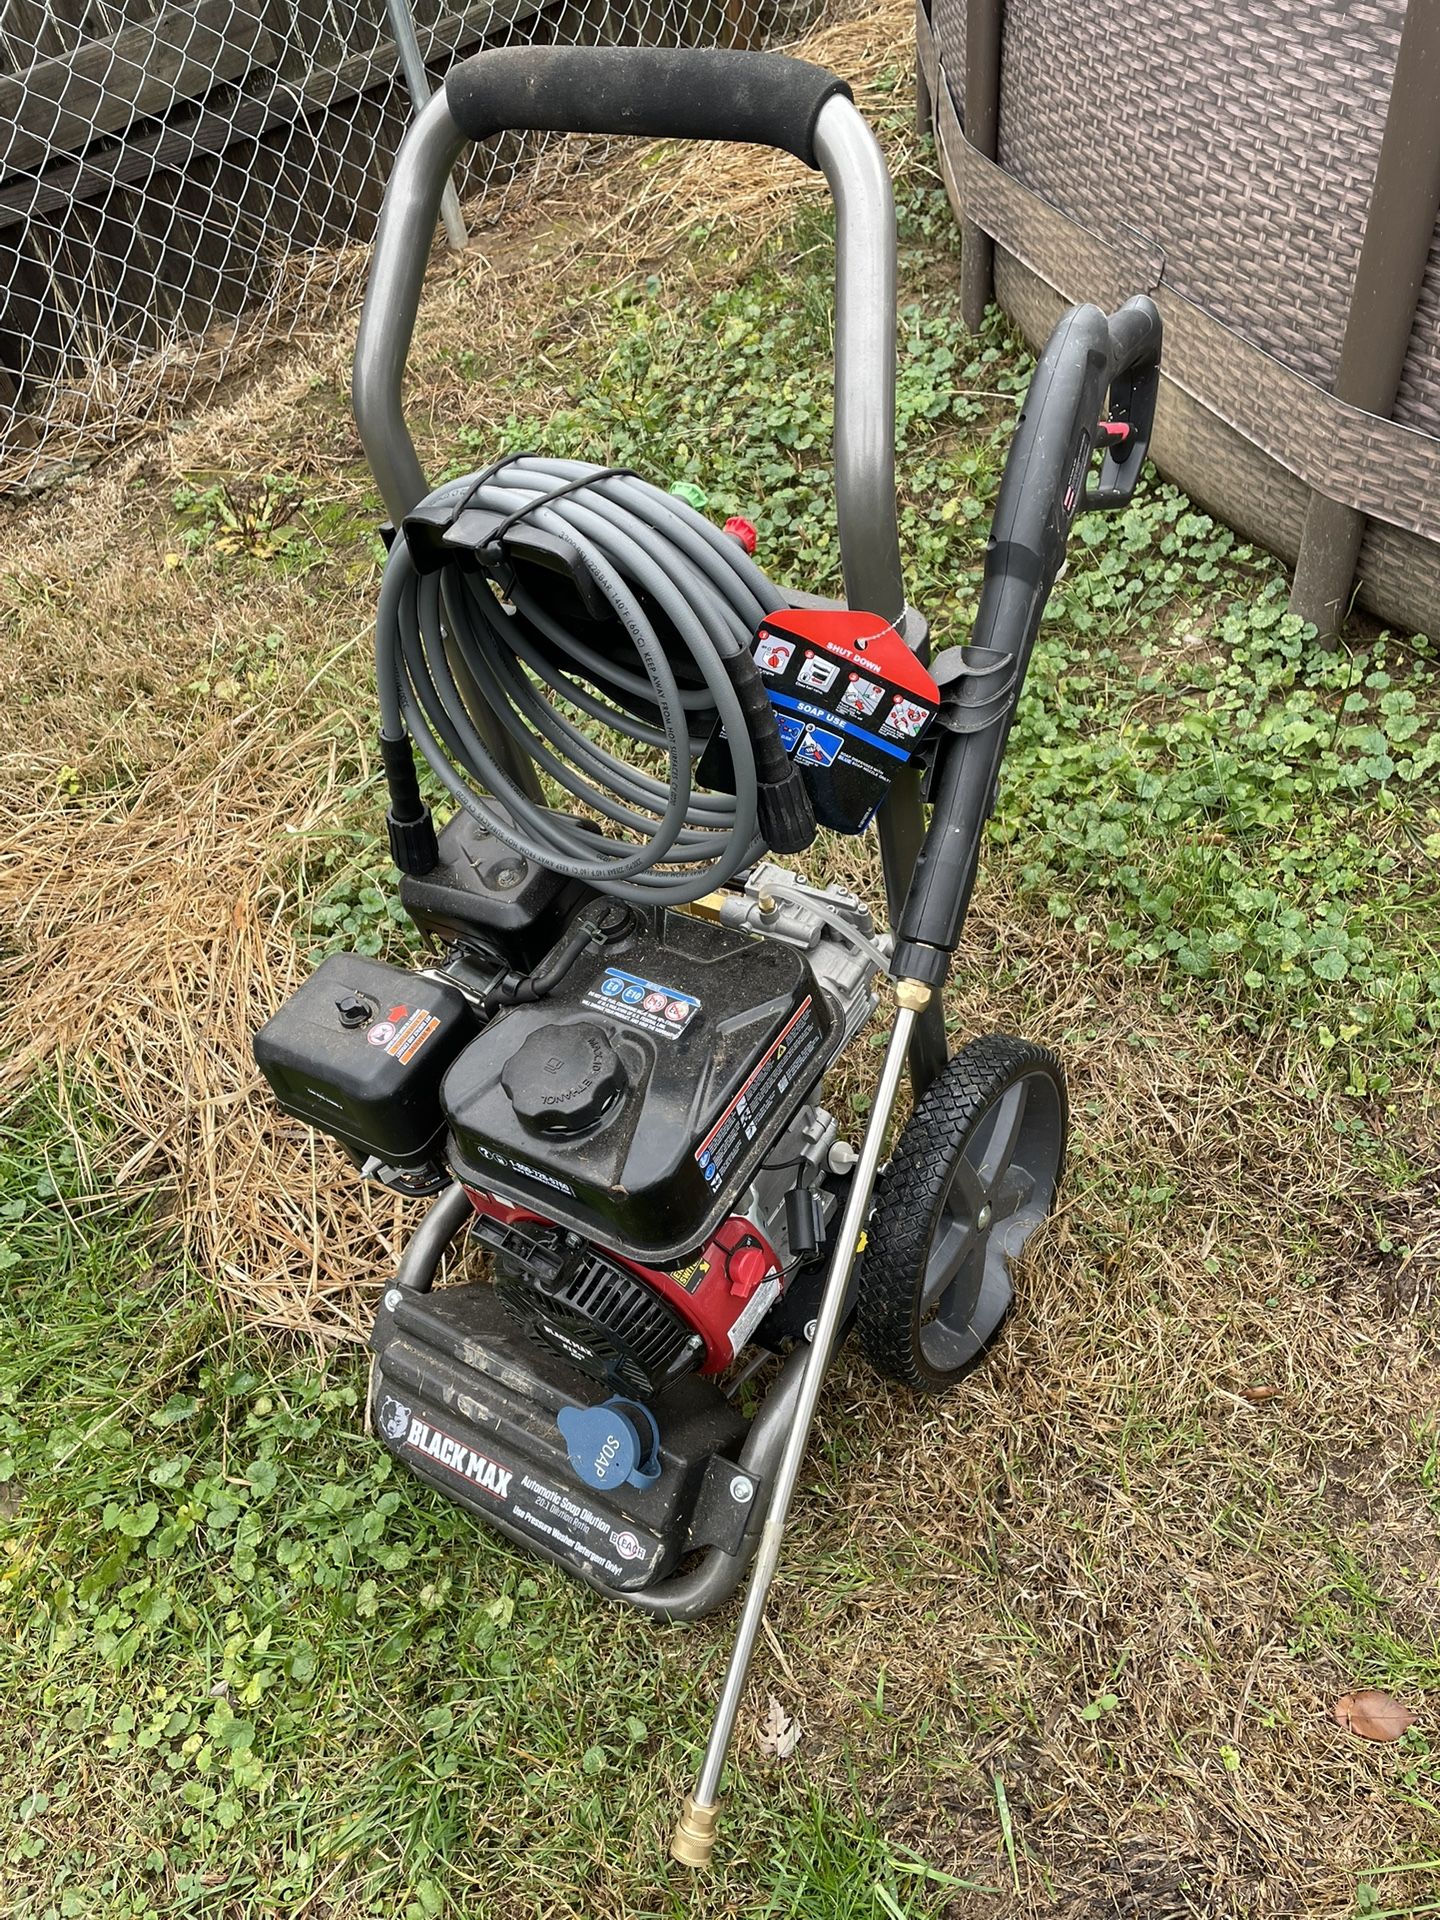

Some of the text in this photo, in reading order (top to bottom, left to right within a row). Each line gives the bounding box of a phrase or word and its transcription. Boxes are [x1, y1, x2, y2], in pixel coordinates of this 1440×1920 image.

[643, 651, 657, 673] KEEP
[826, 642, 882, 673] SHUT DOWN
[652, 674, 666, 699] AWAY
[661, 701, 671, 725] FROM
[797, 702, 824, 717] SOAP
[826, 714, 847, 728] USE
[667, 726, 676, 745] HOT
[670, 745, 679, 779] SURFACES
[476, 813, 505, 839] SURFACES
[505, 838, 518, 848] HOT
[625, 989, 642, 1000] E10
[541, 1079, 593, 1105] ETHANOL
[407, 1418, 513, 1498] BLACK MAX
[594, 1435, 620, 1478] SOAP
[521, 1475, 611, 1534] Automatic Soap Dilution
[535, 1496, 591, 1535] 20:1 Dilution Ratio
[512, 1505, 623, 1576] Use Pressure Washer Detergent Only!
